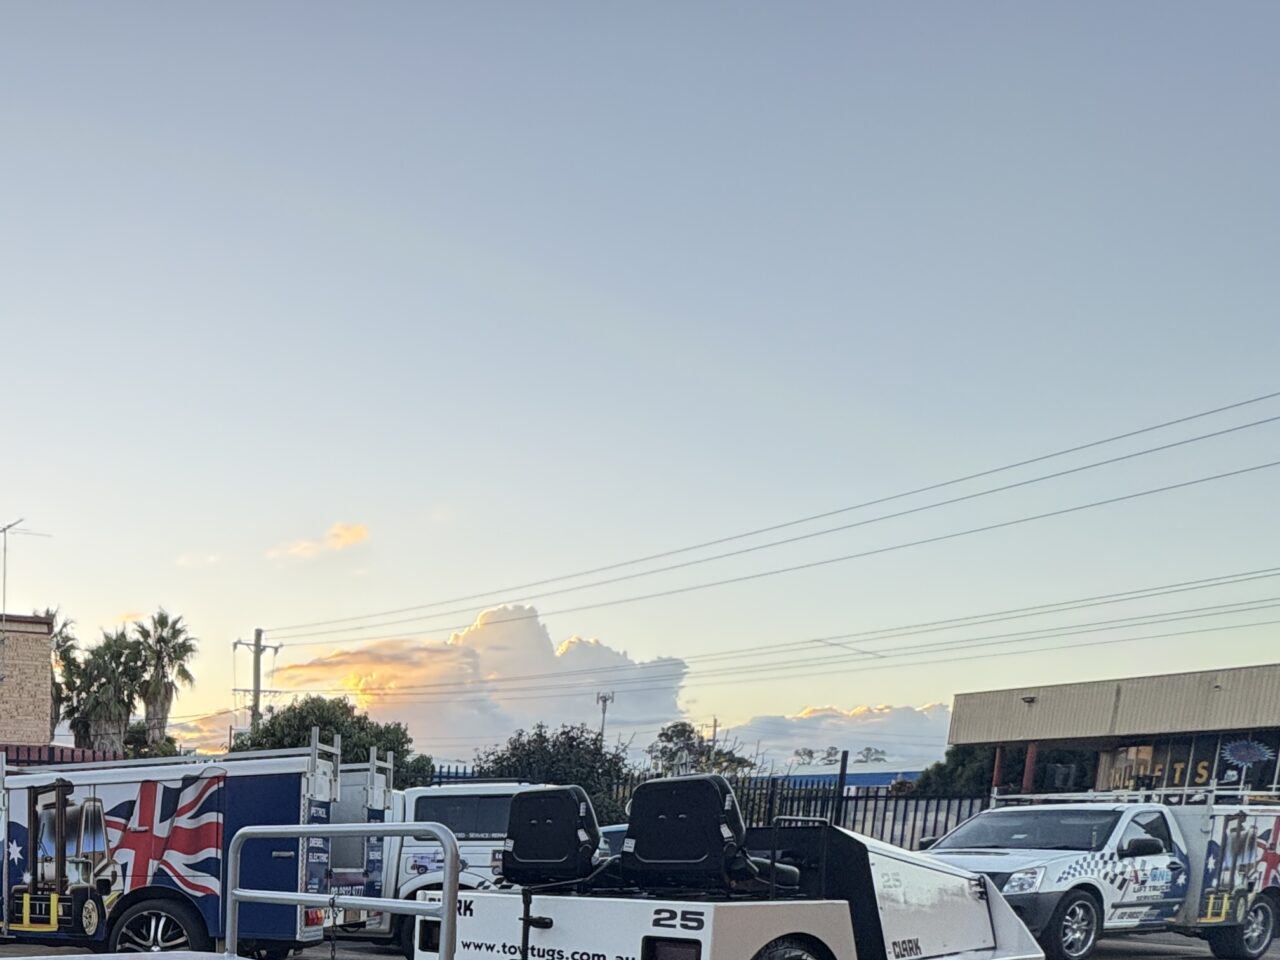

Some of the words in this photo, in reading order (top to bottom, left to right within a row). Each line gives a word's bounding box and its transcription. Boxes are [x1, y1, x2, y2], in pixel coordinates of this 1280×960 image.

[310, 806, 327, 818] PETROL
[308, 852, 329, 863] ELECTRIC
[881, 871, 902, 889] 25
[652, 908, 705, 931] 25
[891, 937, 923, 960] CLARK
